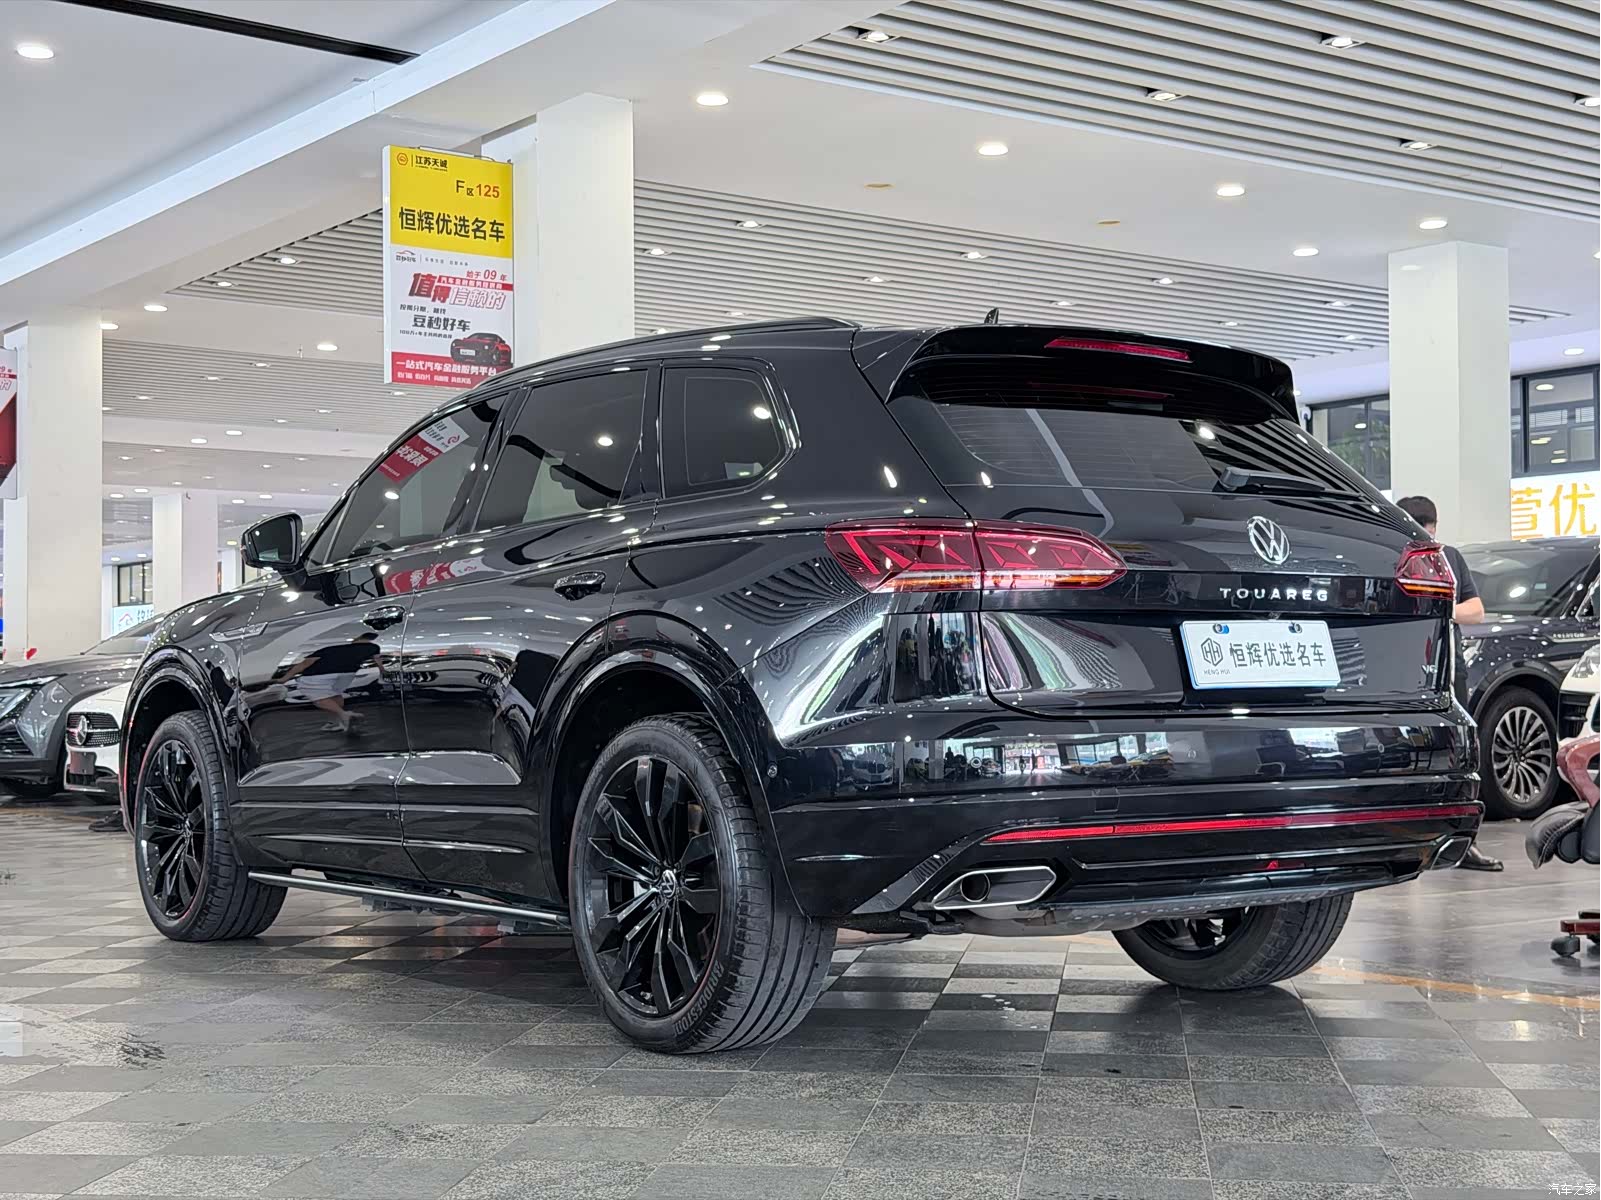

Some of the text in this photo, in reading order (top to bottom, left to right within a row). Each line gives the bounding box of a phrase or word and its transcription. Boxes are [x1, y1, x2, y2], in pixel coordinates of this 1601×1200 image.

[398, 206, 506, 242] 恒辉优选名车
[483, 269, 497, 280] 09
[412, 314, 471, 332] 豆秒好车
[396, 359, 497, 377] 一站式汽车金融服务平台
[1219, 587, 1329, 601] TOUAREG
[1229, 641, 1327, 668] 恒辉优选名车
